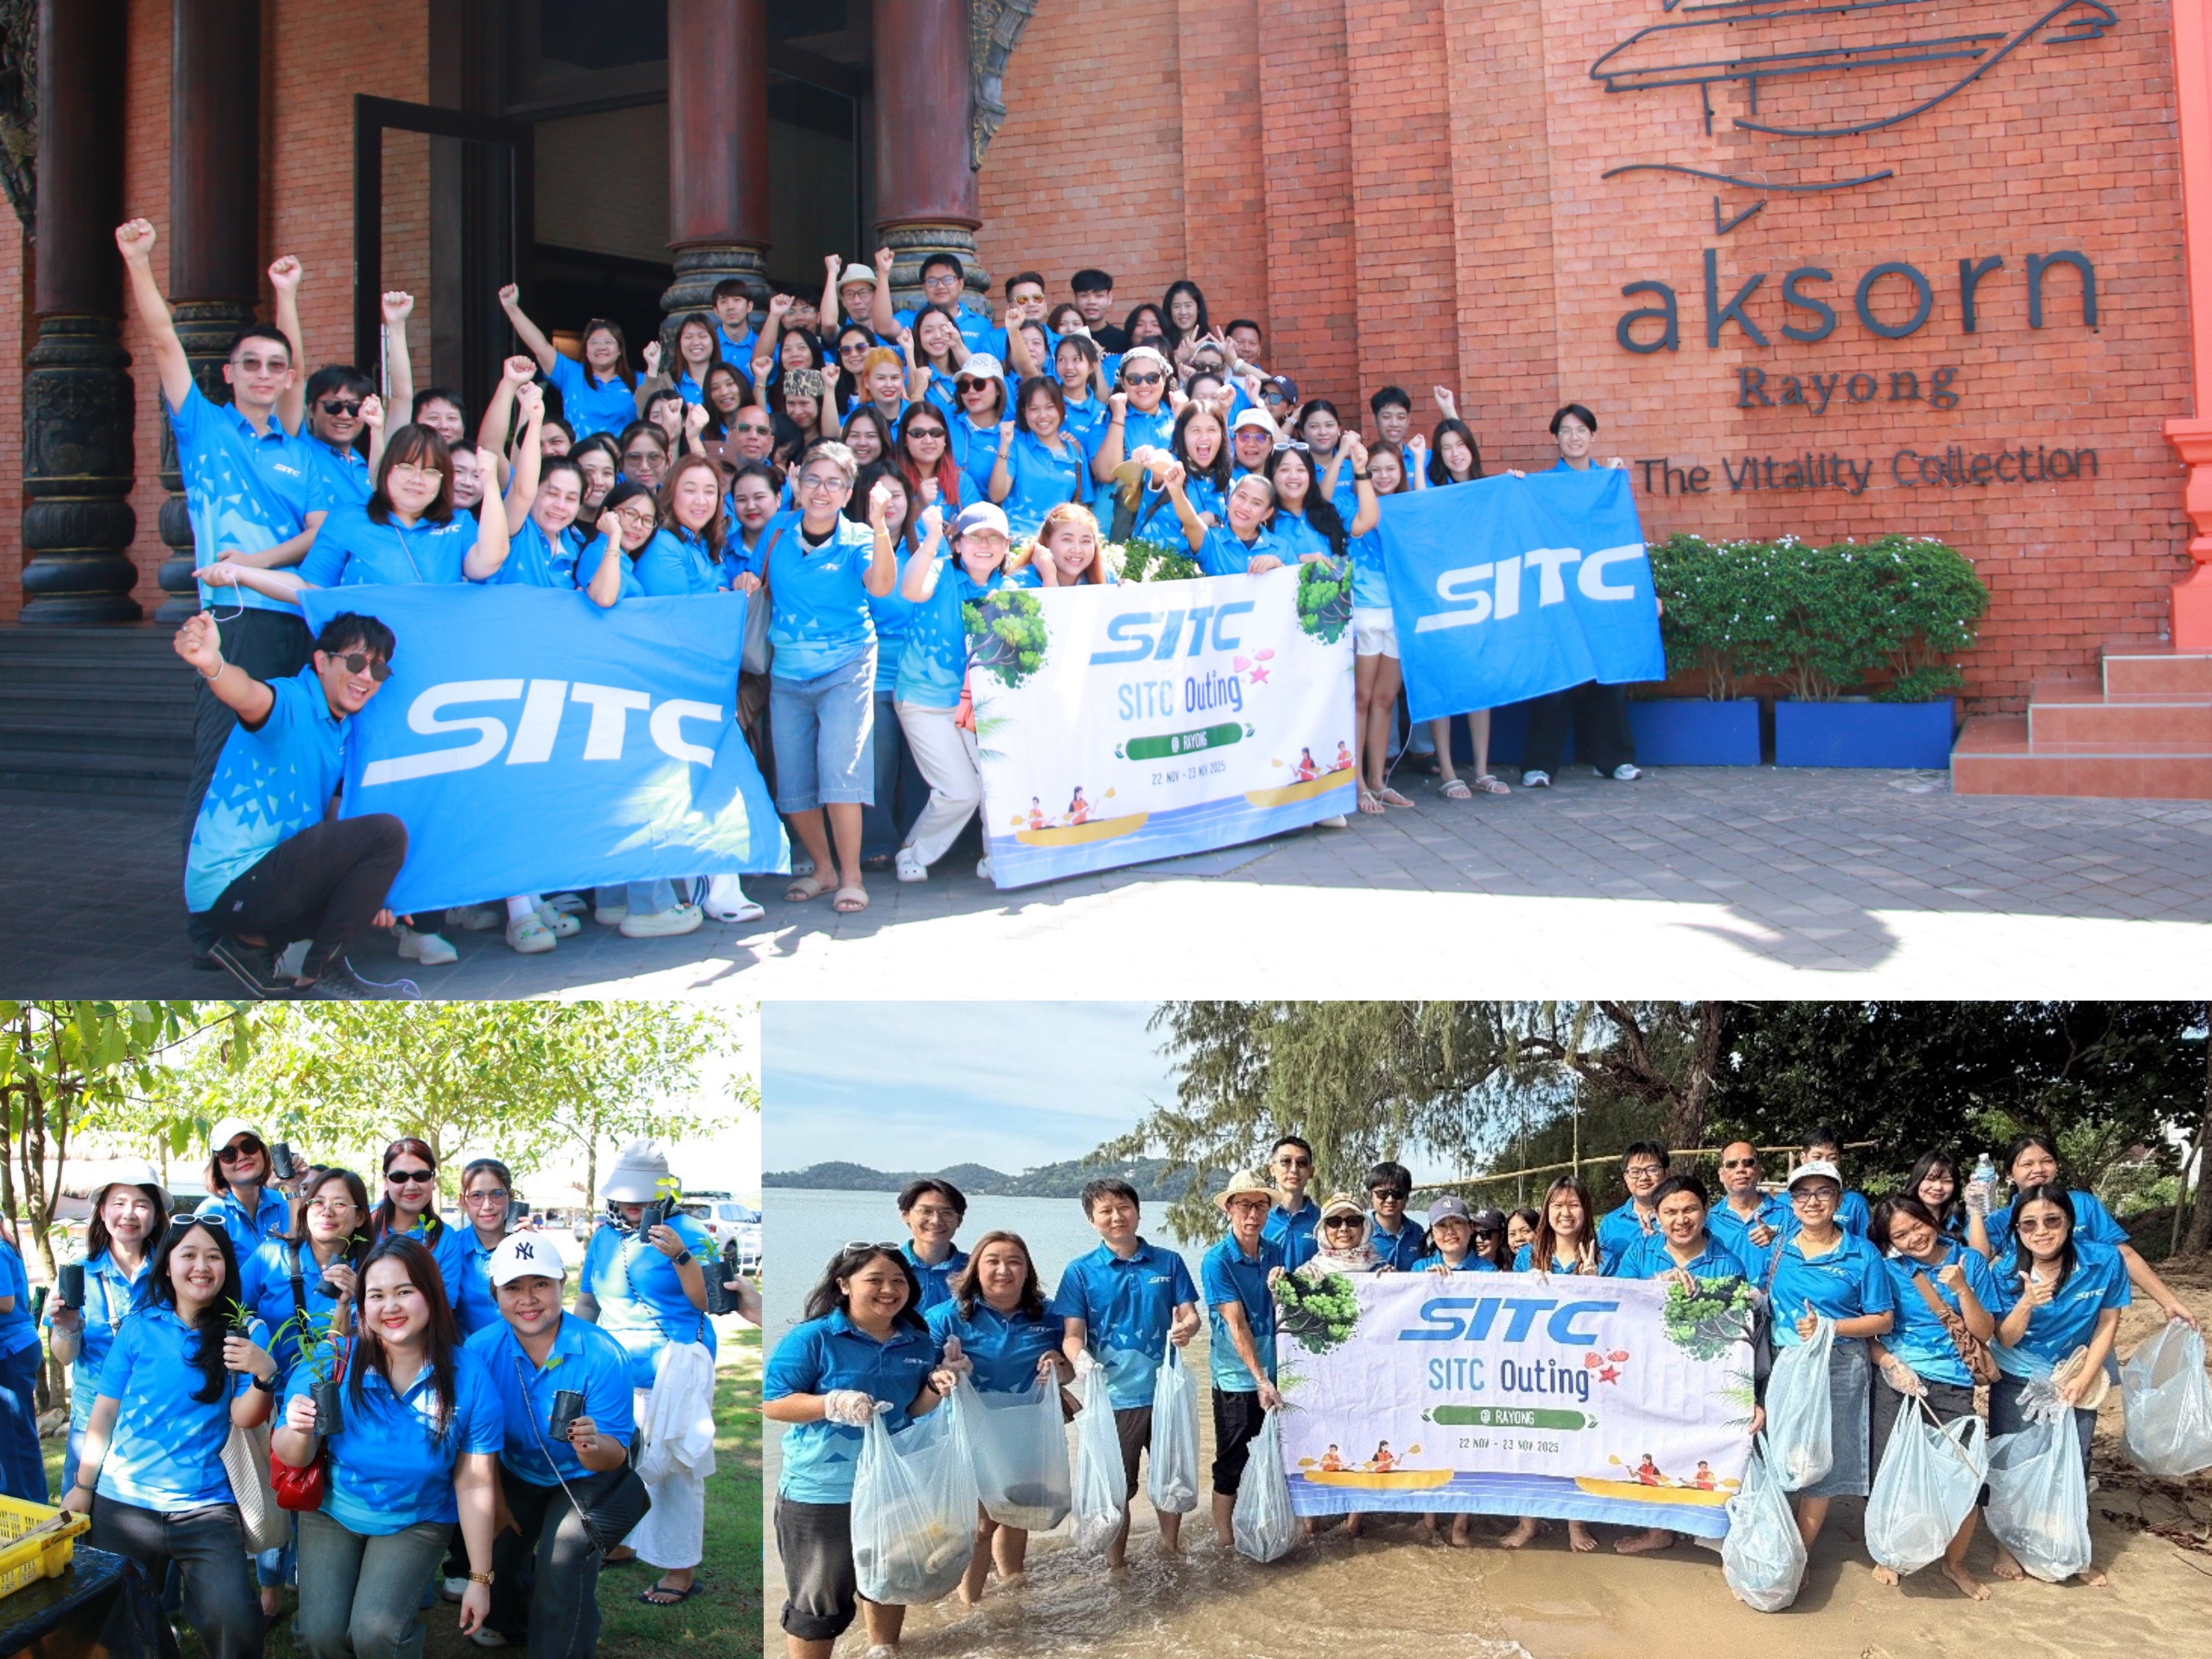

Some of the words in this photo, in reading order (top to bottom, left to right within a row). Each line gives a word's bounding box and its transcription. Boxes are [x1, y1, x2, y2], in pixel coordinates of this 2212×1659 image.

[1615, 247, 2099, 354] aksorn
[1735, 366, 1959, 415] Rayong
[273, 463, 301, 477] SITC
[1635, 457, 1711, 495] The
[1721, 452, 1874, 495] Vitality
[1891, 444, 2099, 488] Collection
[1415, 542, 1644, 634] SITC
[1088, 599, 1255, 666] SITC
[1117, 680, 1174, 721] SITC
[1185, 669, 1243, 713] Outing
[360, 678, 723, 788] SITC
[1171, 736, 1180, 753] @
[1183, 730, 1208, 751] RAYONG
[1151, 772, 1162, 785] 22
[1166, 770, 1180, 784] NOV
[1188, 766, 1196, 779] 23
[1198, 764, 1208, 777] NOV
[1210, 759, 1226, 774] 2025
[515, 1241, 534, 1260] NY
[1147, 1275, 1172, 1284] SITC
[2073, 1288, 2106, 1301] SITC
[1397, 1297, 1620, 1345] SITC
[1428, 1358, 1485, 1391] SITC
[1500, 1358, 1589, 1403] Outing
[1480, 1409, 1491, 1423] @
[1495, 1409, 1535, 1426] RAYONG
[1459, 1438, 1469, 1449] 22
[1473, 1438, 1489, 1449] NOV
[1503, 1439, 1514, 1450] 23
[1518, 1440, 1533, 1451] NOV
[1537, 1441, 1559, 1453] 2025
